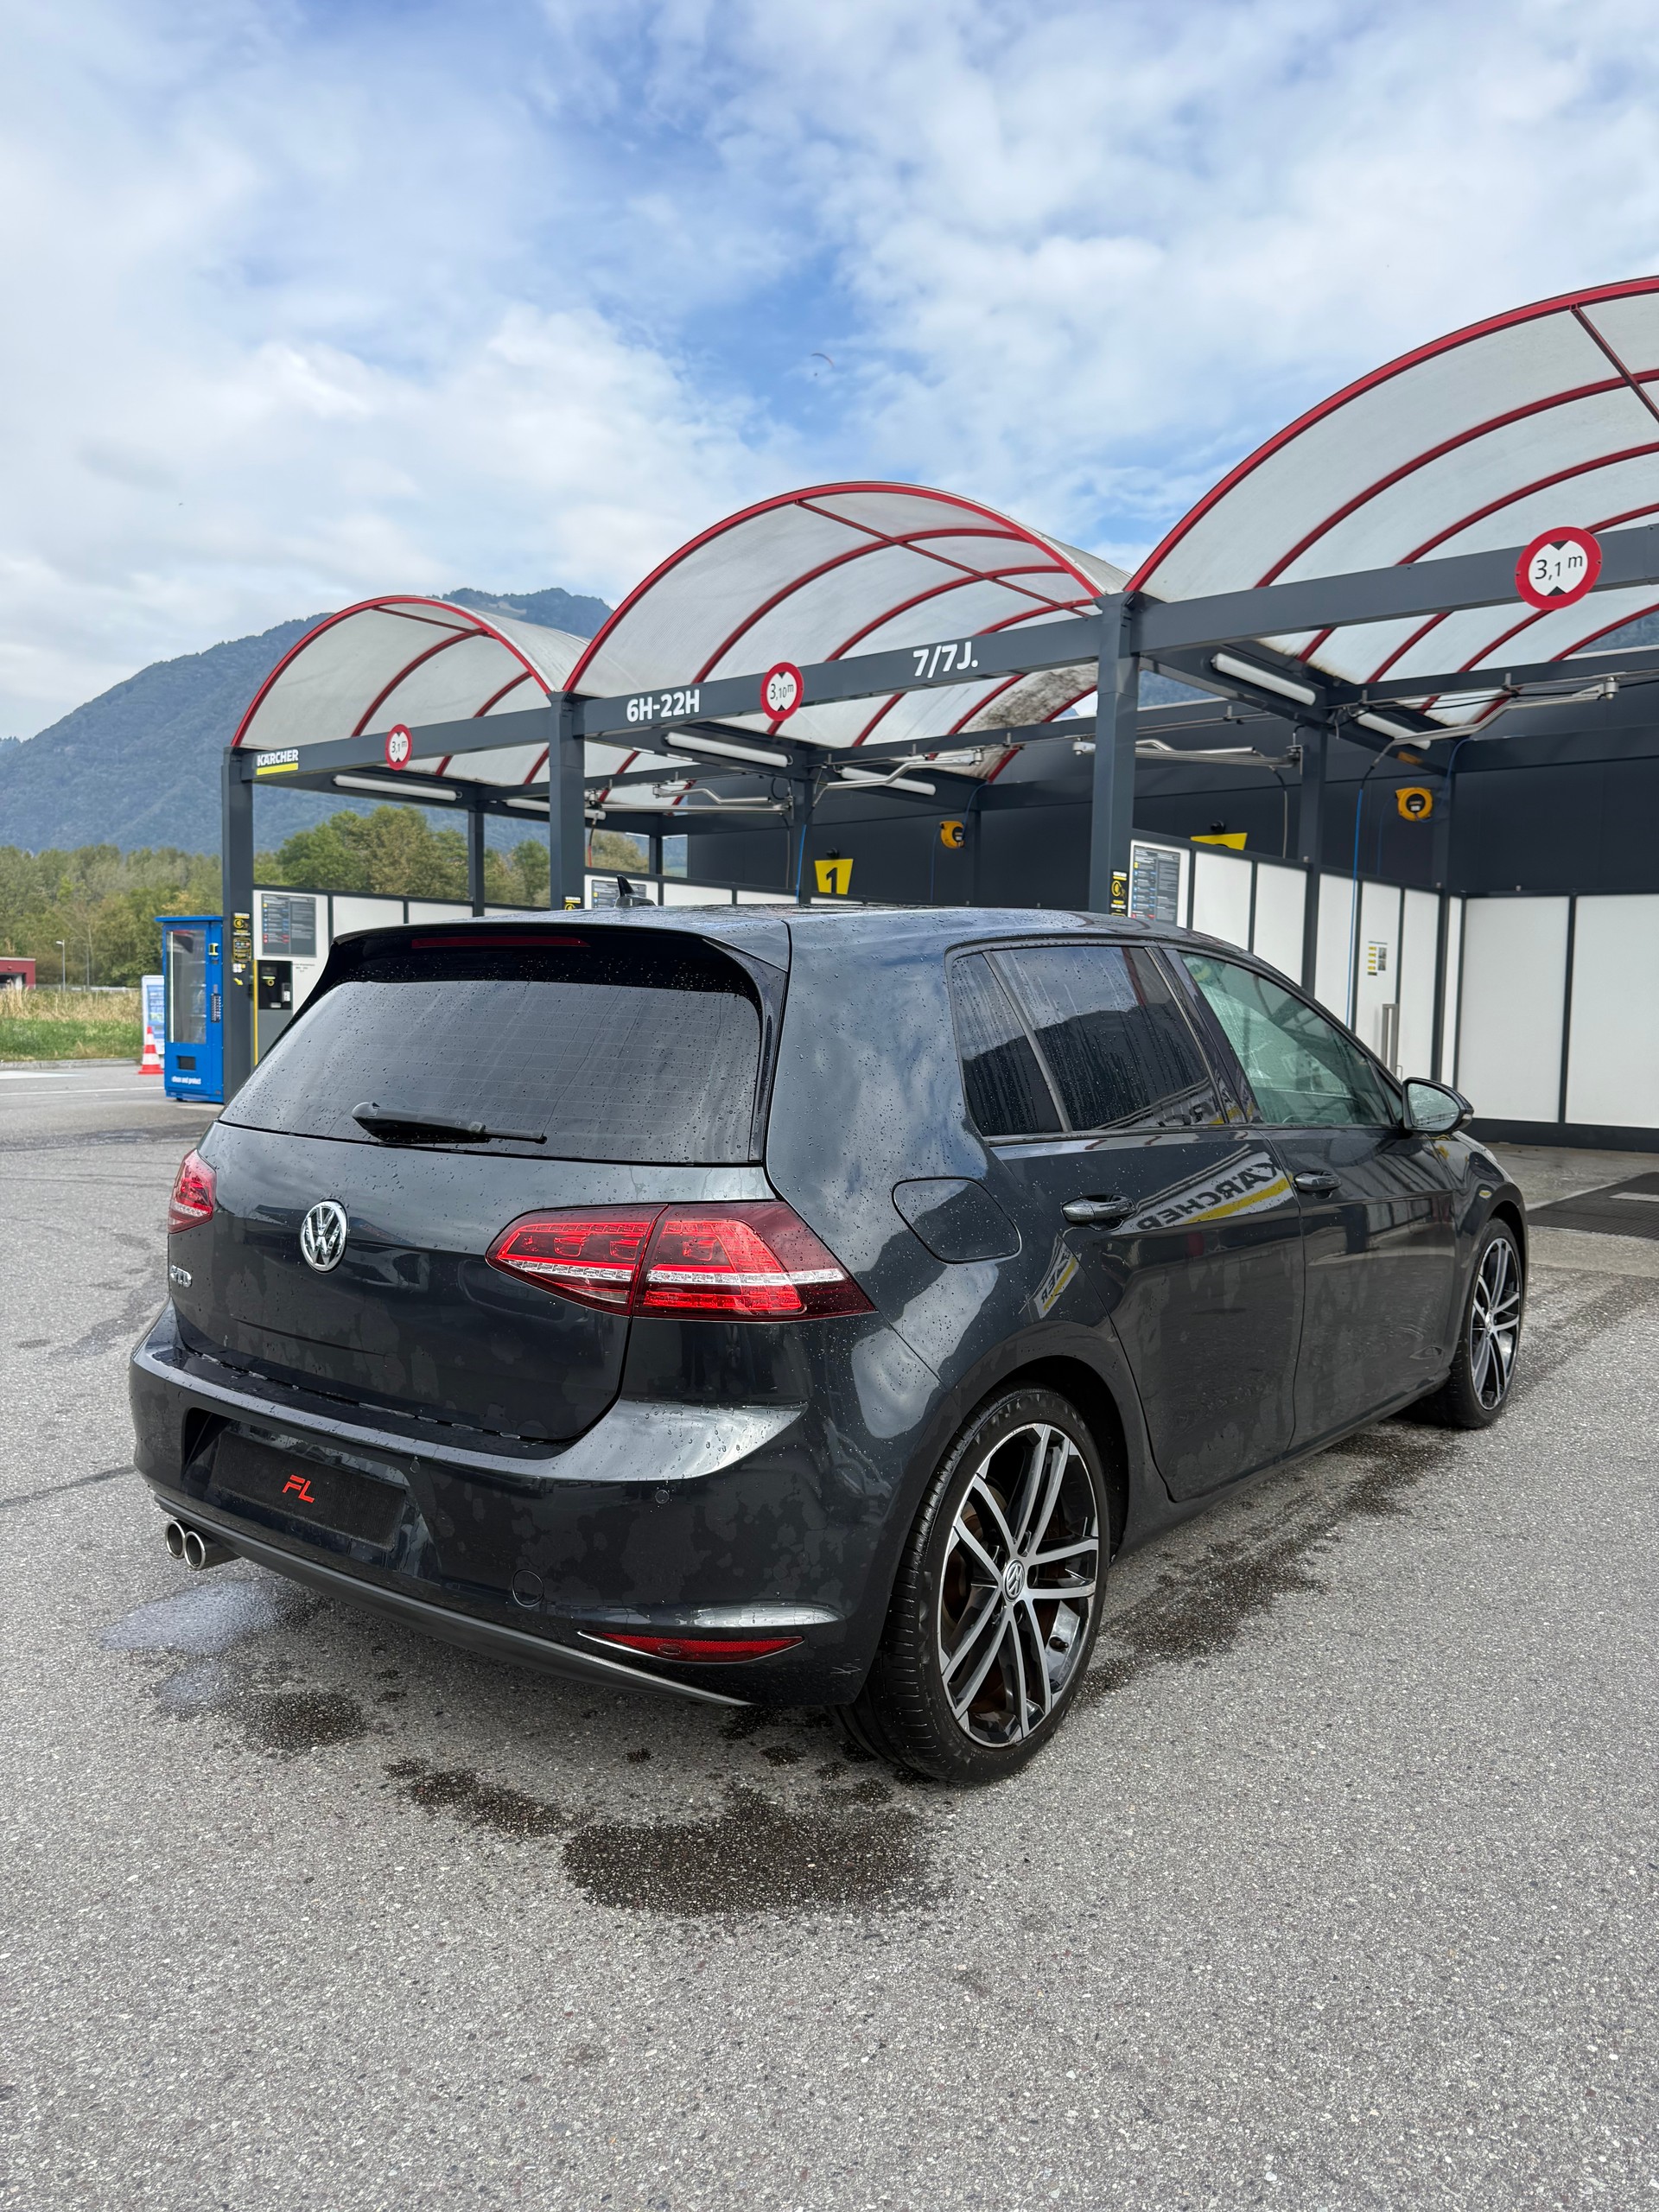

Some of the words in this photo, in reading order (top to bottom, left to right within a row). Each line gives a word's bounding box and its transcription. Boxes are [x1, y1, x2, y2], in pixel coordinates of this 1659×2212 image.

[1535, 559, 1561, 581] 3,1
[912, 641, 978, 678] 7/7J.
[626, 689, 700, 722] 6H-22H
[826, 867, 838, 893] 1
[282, 1474, 315, 1503] FL
